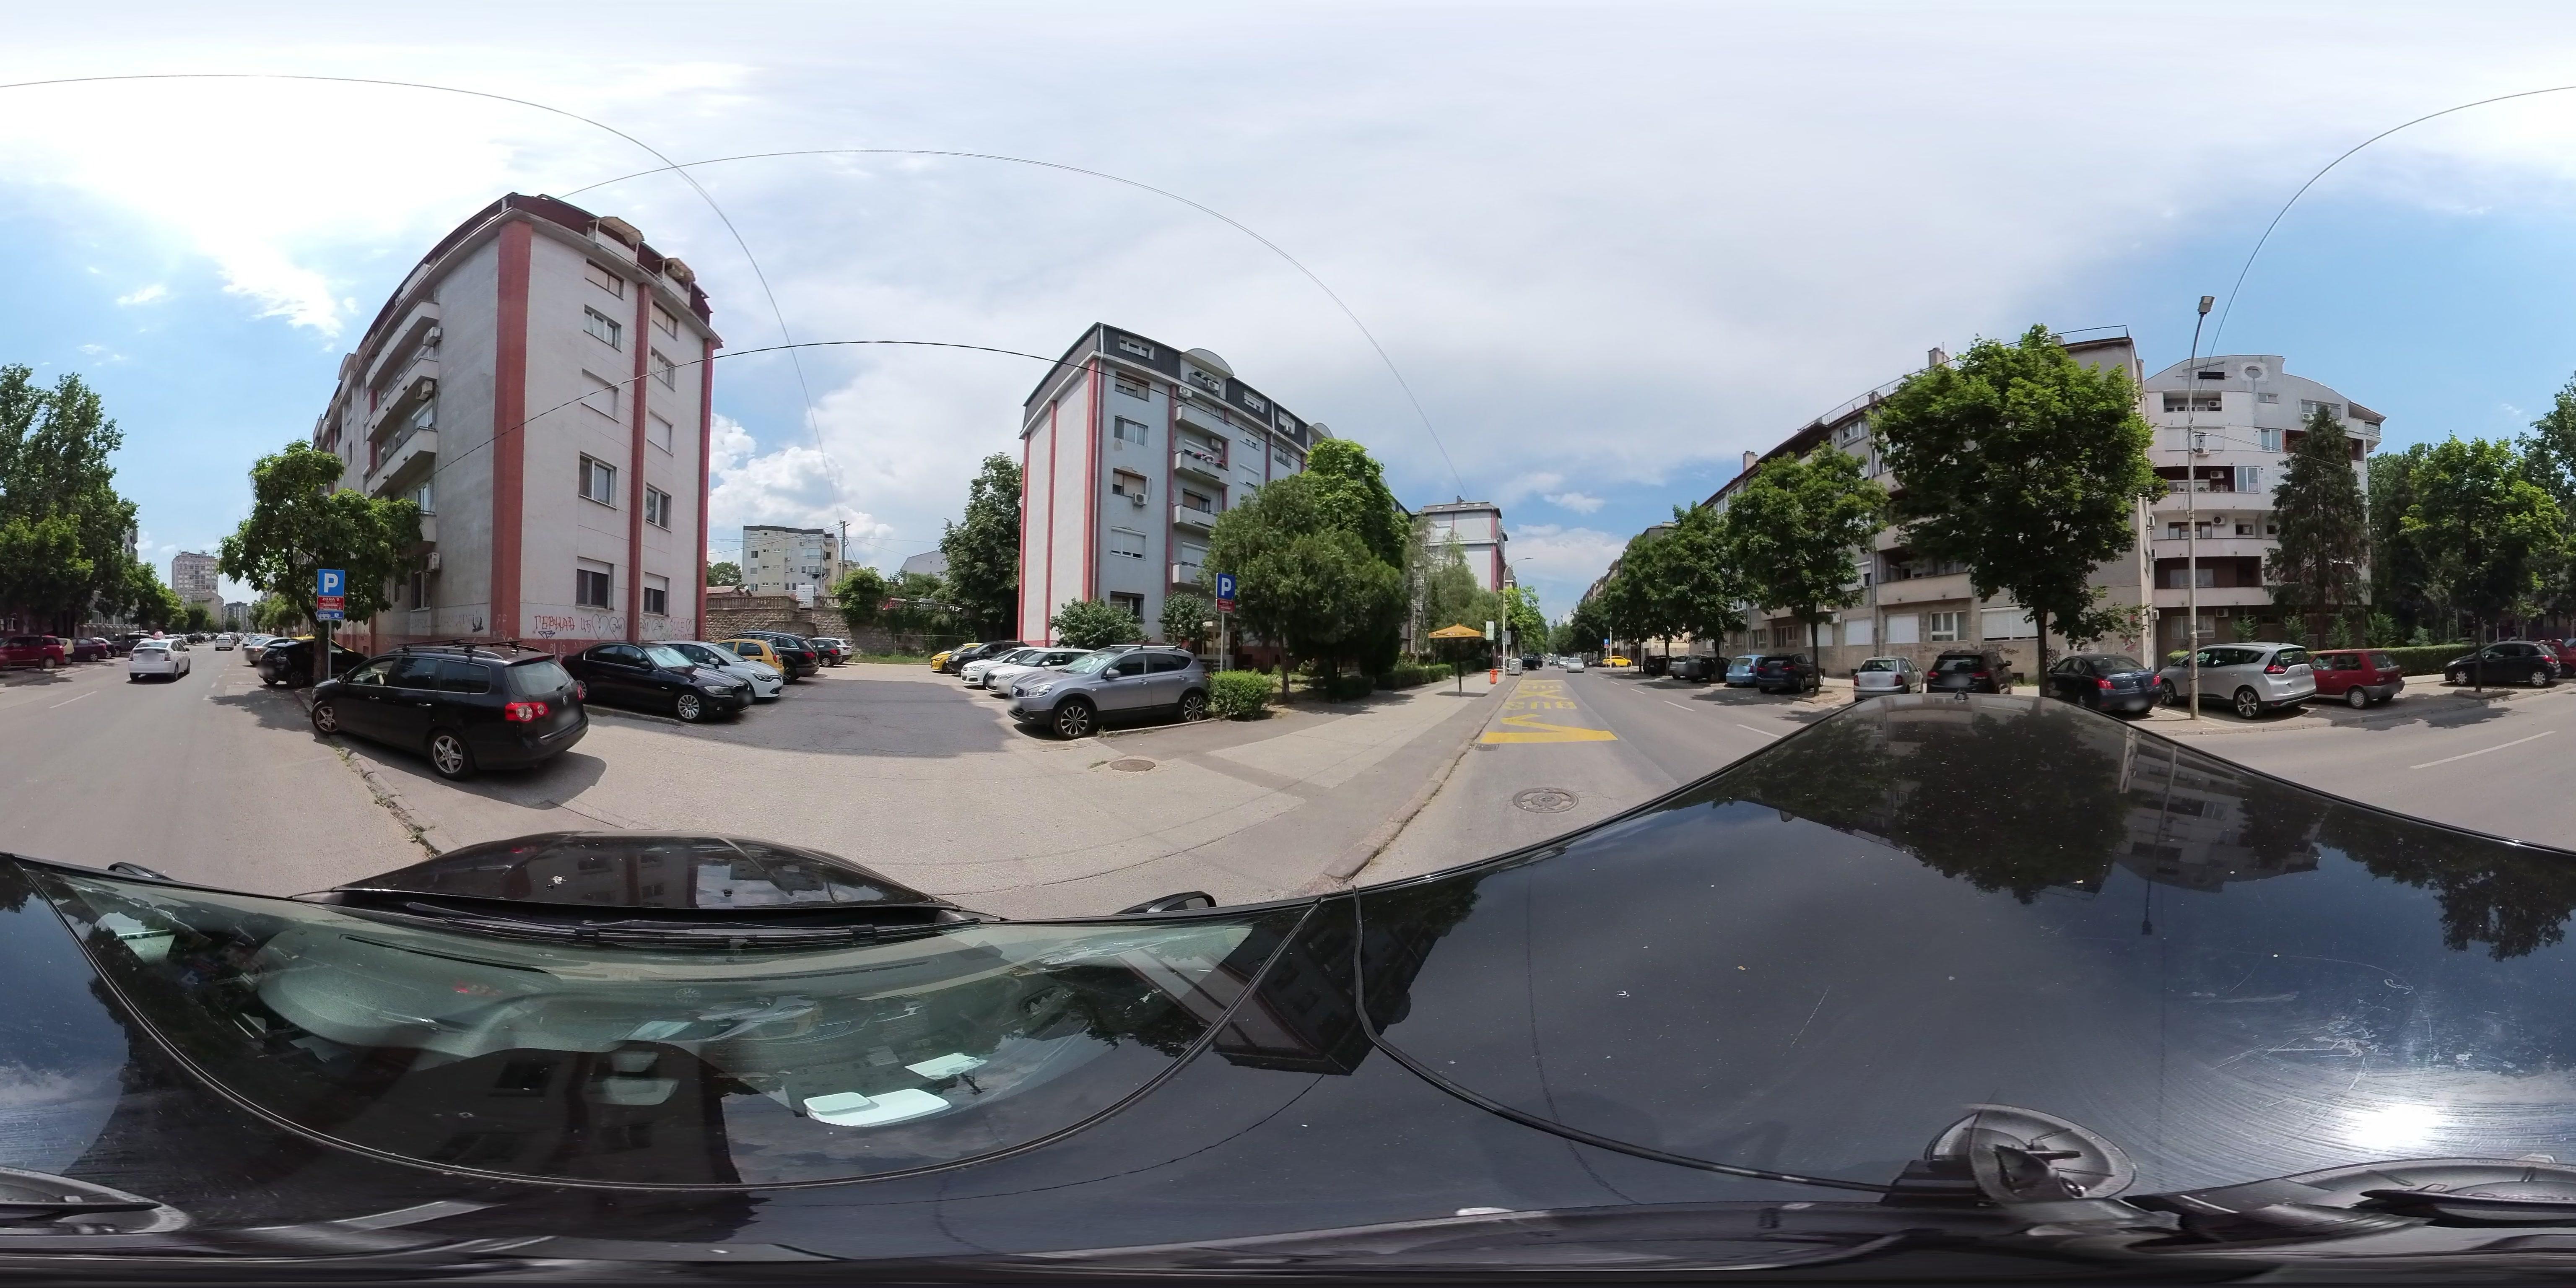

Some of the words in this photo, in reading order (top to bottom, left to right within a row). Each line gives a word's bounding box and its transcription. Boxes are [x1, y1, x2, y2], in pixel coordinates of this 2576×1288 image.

[324, 573, 338, 593] P
[1221, 577, 1231, 596] P
[1503, 701, 1577, 710] BUS
